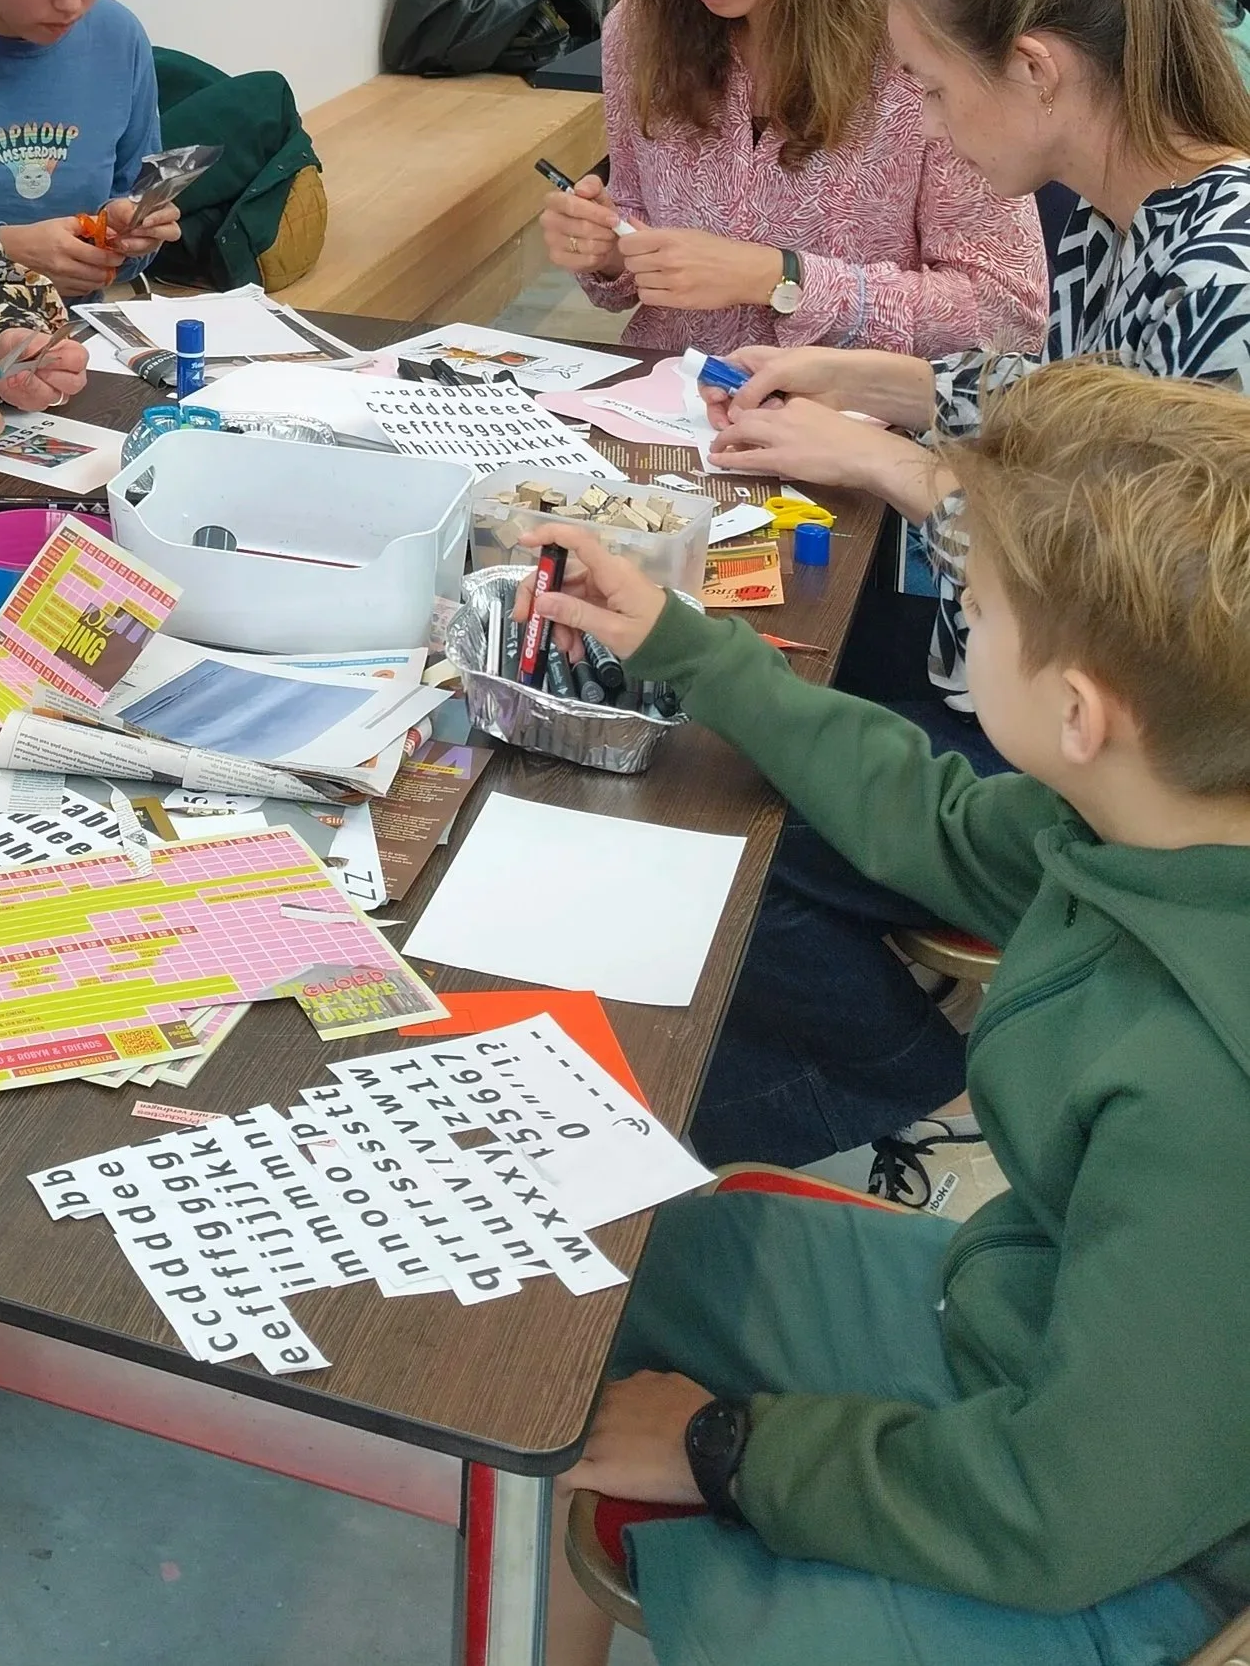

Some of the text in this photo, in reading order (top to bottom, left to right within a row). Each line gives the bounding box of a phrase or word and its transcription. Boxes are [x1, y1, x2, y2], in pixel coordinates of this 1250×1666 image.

[525, 609, 541, 659] eddin
[301, 970, 387, 996] GLOED
[312, 1000, 382, 1025] ORST
[7, 1053, 15, 1063] &
[17, 1048, 50, 1062] ROBYN
[52, 1046, 61, 1055] &
[62, 1039, 104, 1054] FRIENDS
[64, 1059, 80, 1069] NIET
